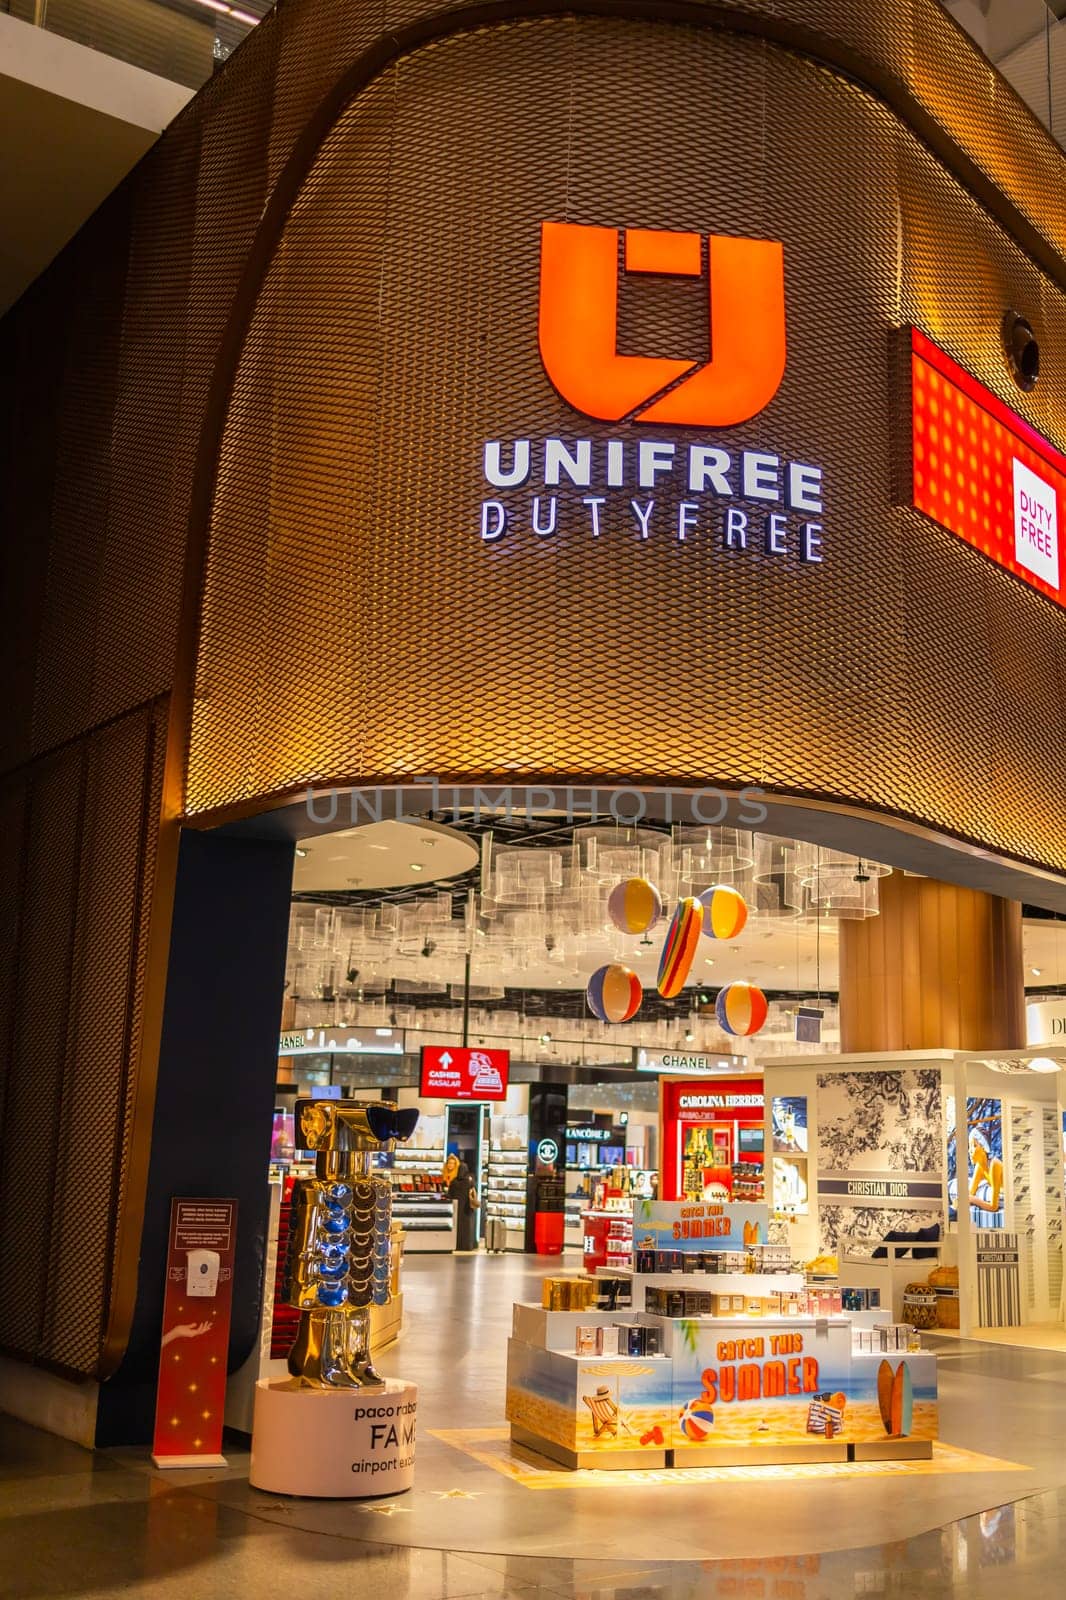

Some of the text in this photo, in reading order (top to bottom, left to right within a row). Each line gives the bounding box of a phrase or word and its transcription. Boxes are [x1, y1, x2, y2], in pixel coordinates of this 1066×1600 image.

[483, 439, 823, 514] UNIFREE
[1020, 490, 1053, 531] DUTY
[1021, 516, 1053, 558] FREE
[662, 1055, 712, 1070] CHANEL
[680, 1095, 725, 1108] CAROLINA
[847, 1181, 908, 1196] CHRISTIAN DIOR
[680, 1204, 724, 1218] CATCH THIS
[672, 1216, 731, 1240] SUMMER
[717, 1333, 803, 1361] CATCH THIS
[701, 1356, 819, 1405] SUMMER
[355, 1407, 394, 1421] paco
[351, 1458, 397, 1475] airport
